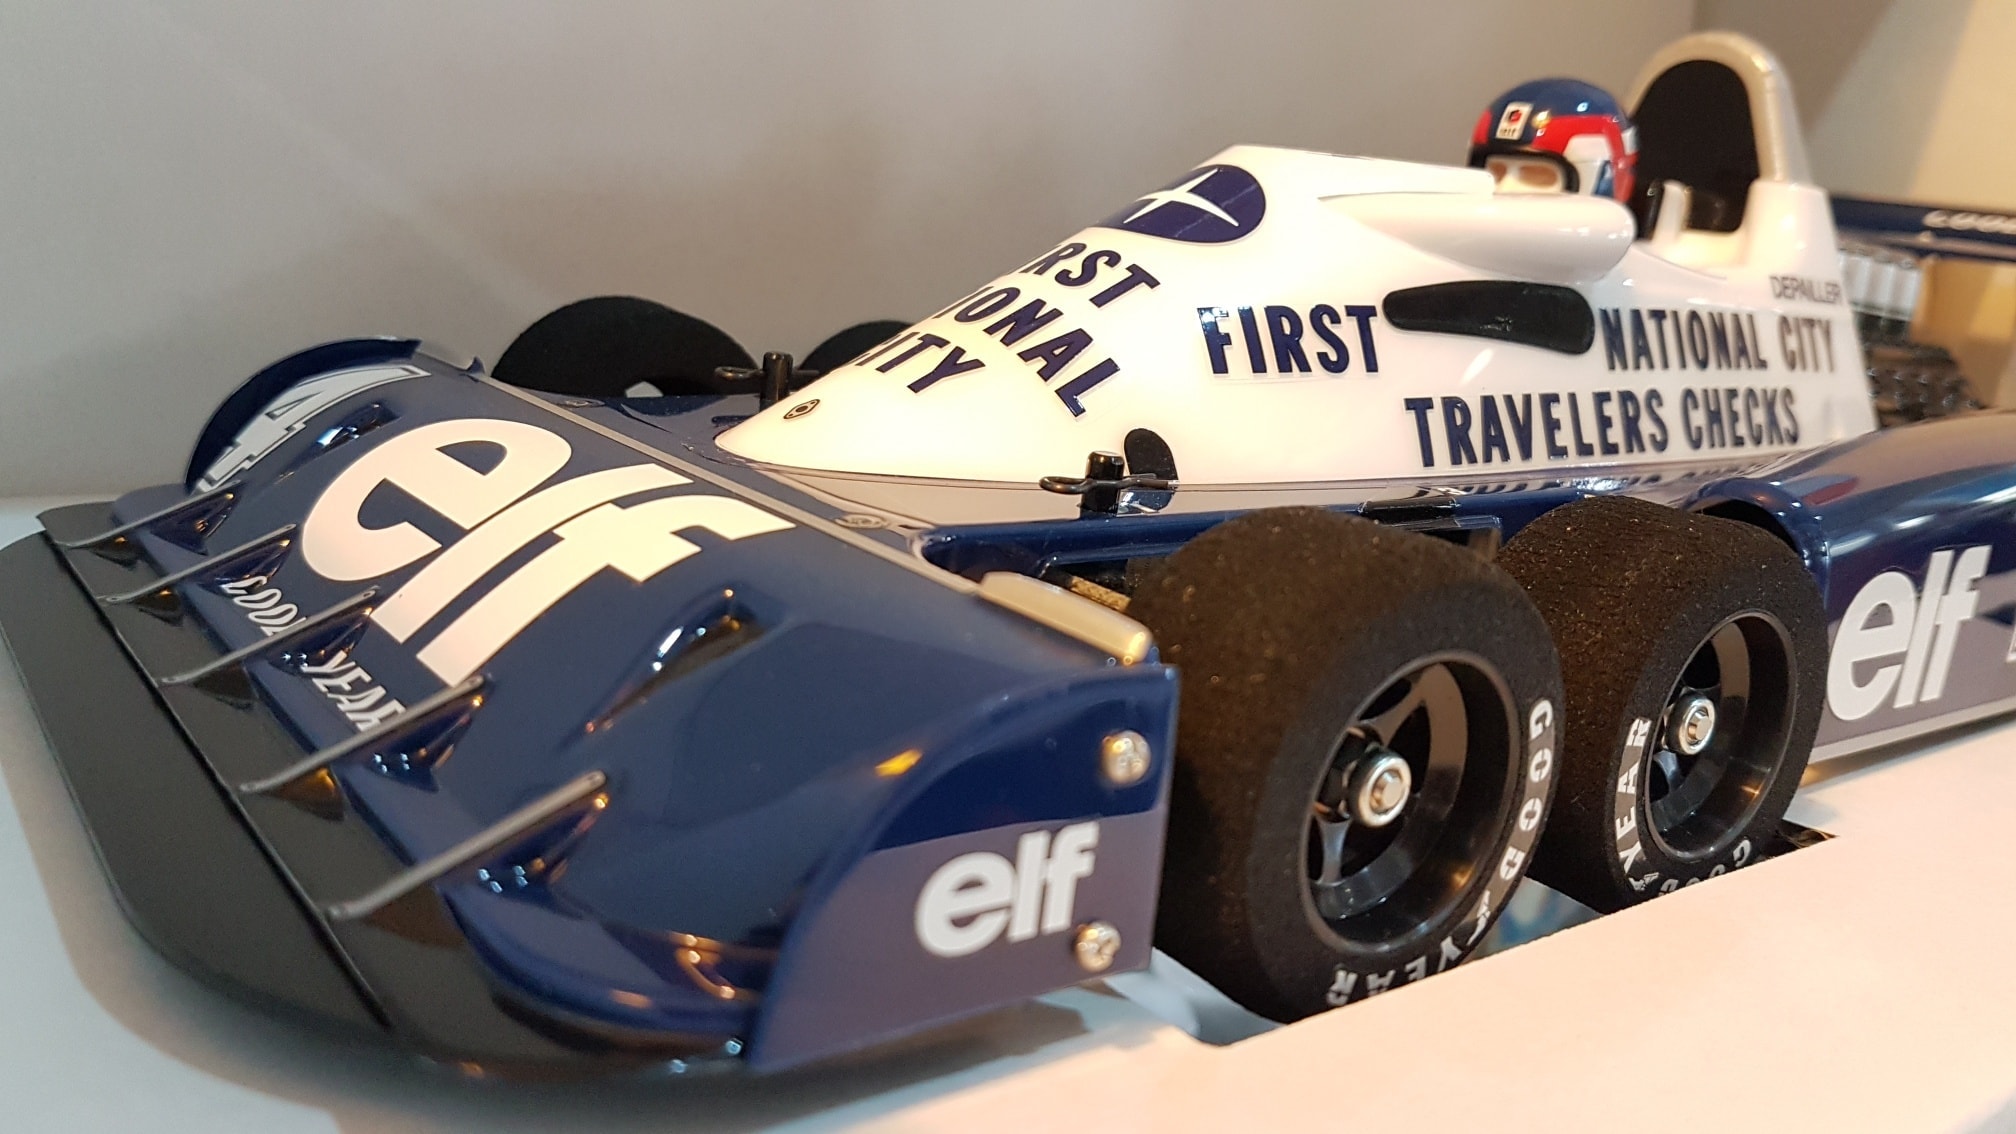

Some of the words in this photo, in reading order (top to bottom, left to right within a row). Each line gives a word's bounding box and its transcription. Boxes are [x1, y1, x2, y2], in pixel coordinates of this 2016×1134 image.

[1018, 243, 1161, 308] RST
[1769, 275, 1842, 304] DEPAILLER
[855, 332, 986, 393] ITY
[1197, 304, 1378, 374] FIRST
[1599, 308, 1767, 372] NATIONAL
[1780, 309, 1836, 373] CITY
[1404, 389, 1669, 468] TRAVELERS
[1680, 387, 1799, 450] CHECKS
[302, 418, 797, 687] elf
[1827, 545, 1992, 721] elf
[1494, 699, 1556, 881] GOOD
[1615, 717, 1653, 874] YEAR
[914, 821, 1101, 957] elf
